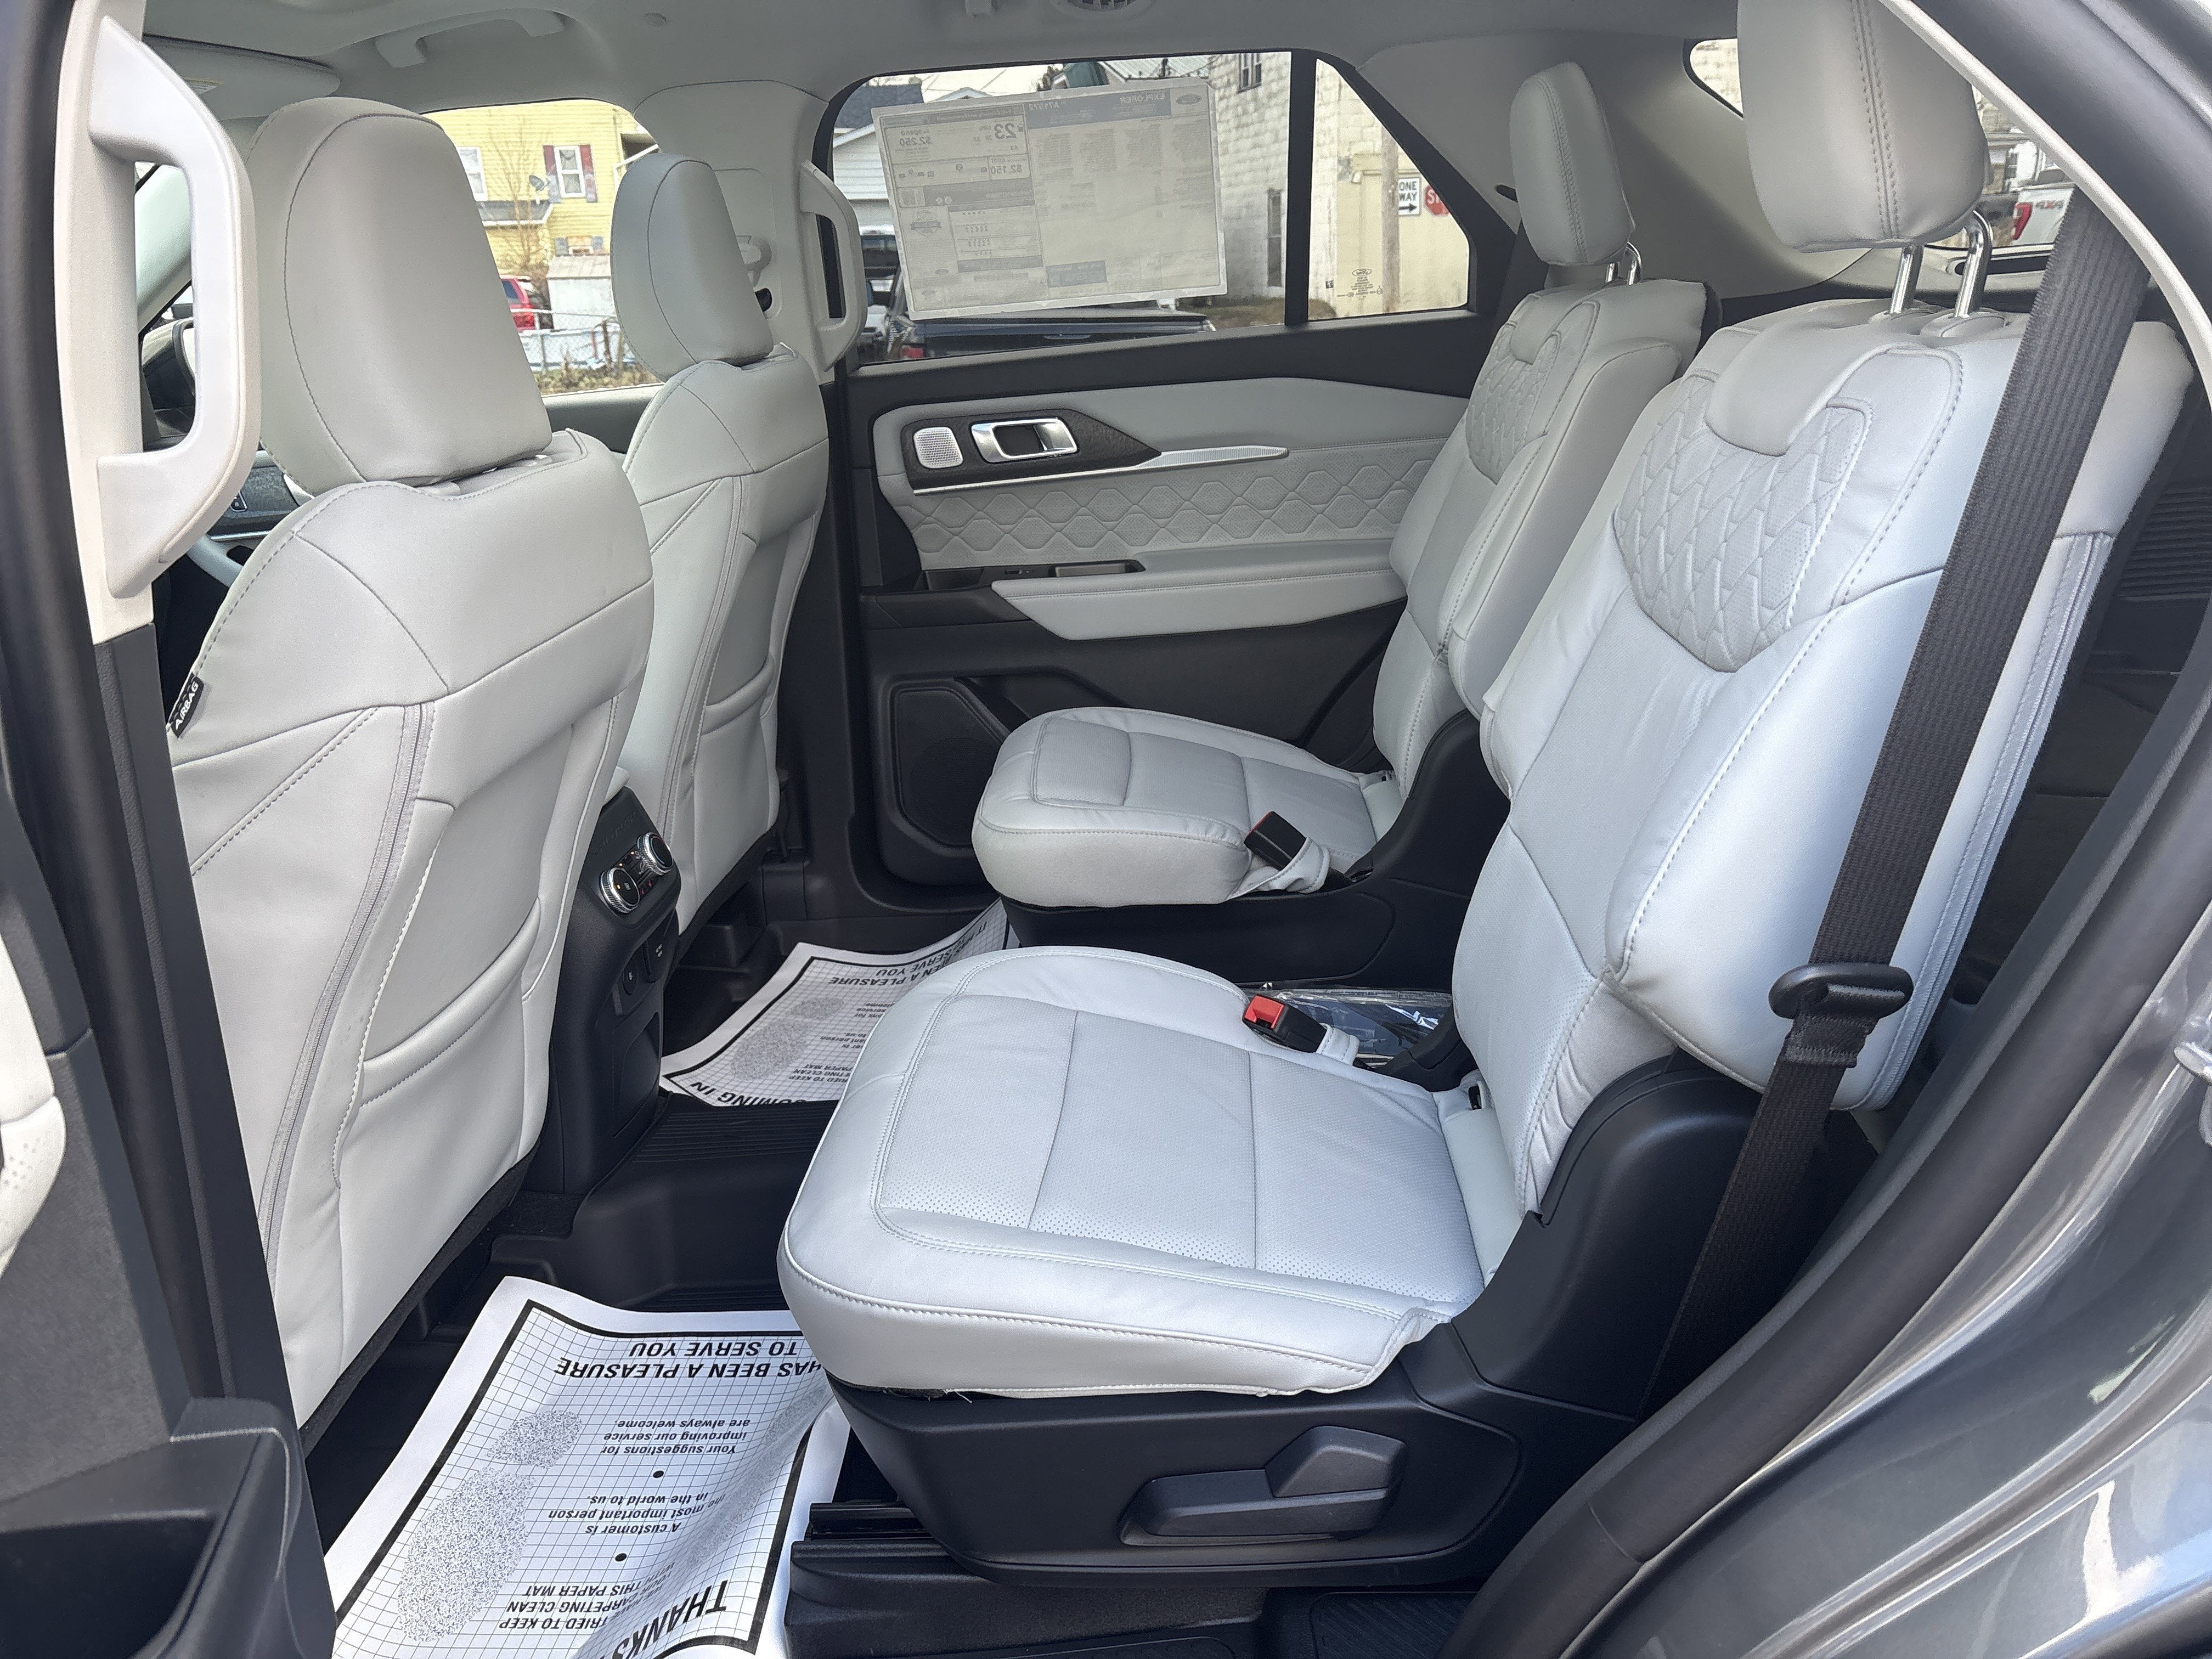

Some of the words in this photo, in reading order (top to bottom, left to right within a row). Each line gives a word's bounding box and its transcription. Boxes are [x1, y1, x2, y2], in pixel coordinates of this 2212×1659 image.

[1399, 182, 1417, 191] ONE
[1400, 192, 1418, 201] WAY
[1427, 189, 1442, 204] ST
[176, 681, 199, 730] AIRBAG
[909, 950, 951, 973] SERVE
[827, 977, 906, 986] PLEASURE
[691, 1082, 716, 1095] IN
[629, 1342, 677, 1357] YOU
[684, 1342, 761, 1357] SERVE
[769, 1341, 797, 1357] TO
[553, 1357, 680, 1379] PLEASURE
[688, 1363, 704, 1378] A
[707, 1363, 770, 1378] BEEN
[614, 1420, 675, 1429] welcome.
[681, 1418, 725, 1429] always
[729, 1420, 750, 1428] are
[603, 1433, 651, 1442] service
[654, 1432, 678, 1441] our
[681, 1432, 747, 1442] improving
[601, 1446, 620, 1455] for
[624, 1444, 703, 1455] suggestions
[706, 1446, 736, 1454] Your
[586, 1496, 603, 1504] us.
[607, 1496, 624, 1505] to
[628, 1496, 665, 1506] world
[670, 1495, 691, 1505] the
[696, 1492, 708, 1501] in
[548, 1507, 597, 1519] person
[600, 1506, 668, 1520] important
[670, 1505, 703, 1519] most
[585, 1525, 596, 1535] is
[601, 1525, 668, 1535] customer
[672, 1522, 681, 1532] A
[523, 1585, 556, 1596] MAT
[561, 1585, 606, 1596] PAPER
[610, 1581, 641, 1596] THIS
[506, 1601, 556, 1612] CLEAN
[559, 1593, 637, 1612] CARPETING
[499, 1618, 539, 1628] KEEP
[543, 1618, 559, 1629] TO
[566, 1616, 607, 1629] TRIED
[612, 1580, 728, 1659] THANKS
